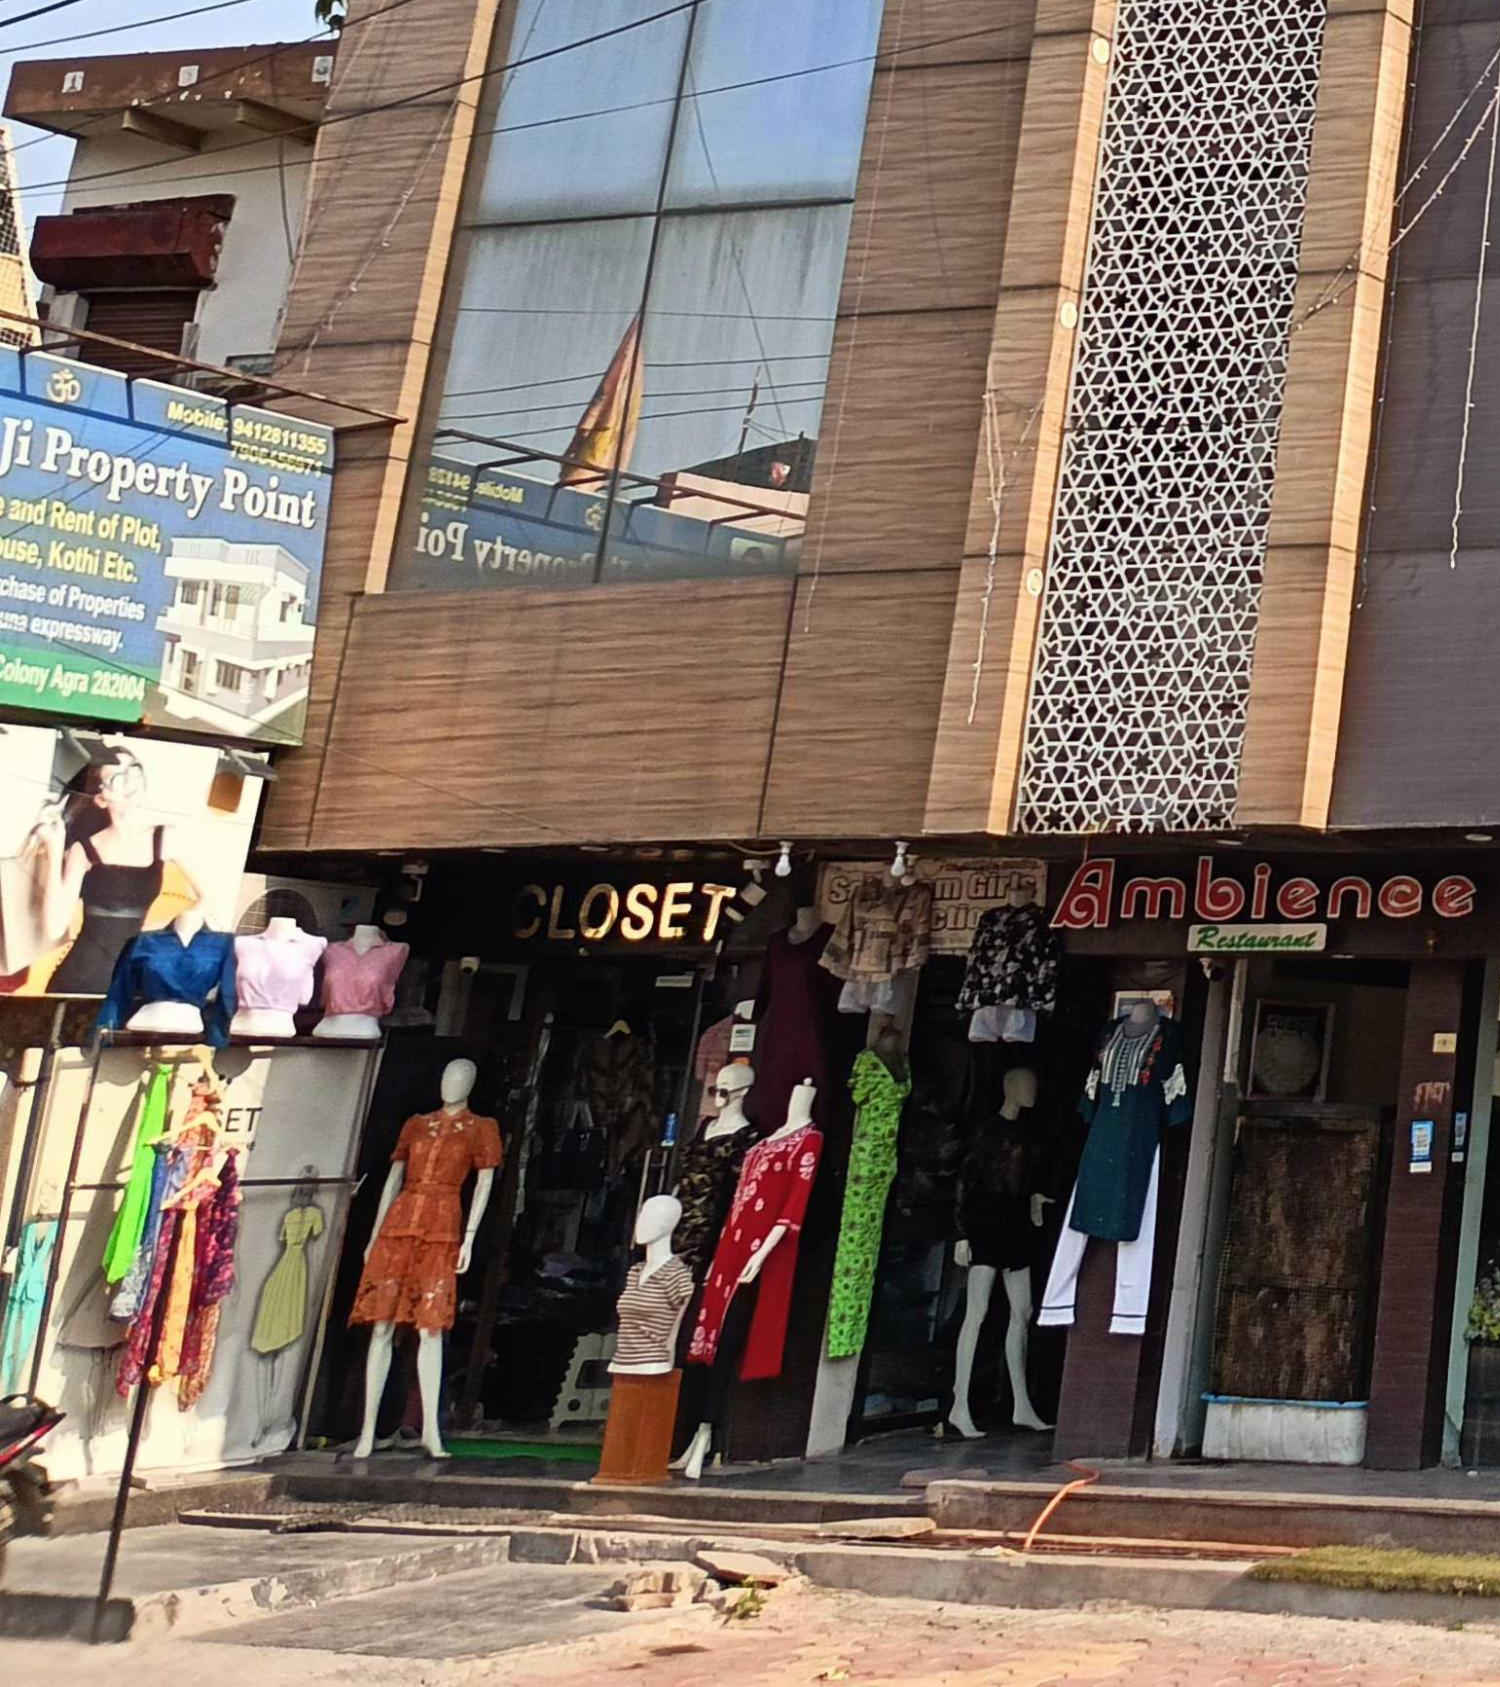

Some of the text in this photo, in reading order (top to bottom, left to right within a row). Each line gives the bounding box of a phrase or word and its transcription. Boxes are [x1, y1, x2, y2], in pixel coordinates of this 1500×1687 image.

[40, 425, 214, 519] Property
[220, 467, 317, 529] Point
[8, 497, 48, 525] and
[50, 500, 94, 536] Rent
[98, 513, 119, 541] of
[121, 516, 162, 553] Plot,
[49, 540, 101, 576] Kothi
[103, 550, 138, 583] Etc.
[49, 584, 68, 605] of
[67, 586, 145, 620] Properties
[52, 664, 89, 697] Agra
[91, 669, 146, 702] 282004
[513, 882, 737, 942] CLOSET
[1194, 925, 1318, 950] Restaurant
